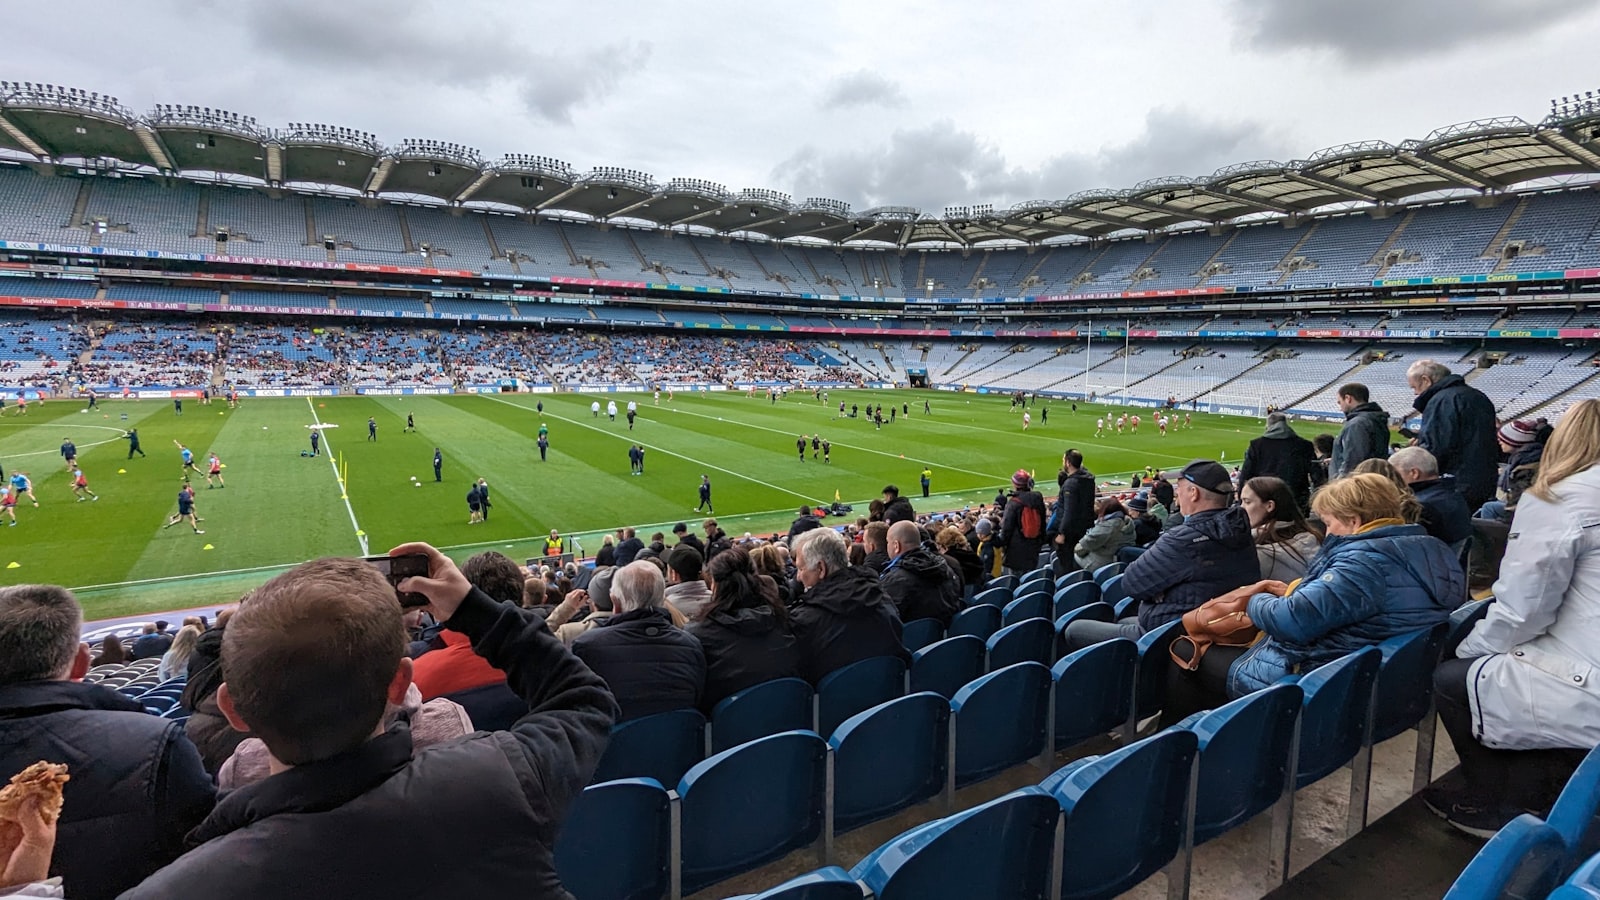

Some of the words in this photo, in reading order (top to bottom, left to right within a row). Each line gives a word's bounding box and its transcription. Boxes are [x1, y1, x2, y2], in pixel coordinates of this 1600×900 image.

[43, 243, 79, 253] Allianz
[102, 247, 135, 256] Allianz
[158, 250, 189, 260] Allianz
[1486, 273, 1517, 281] Centra
[21, 297, 58, 305] SuperValu
[401, 310, 424, 318] Allianz
[441, 312, 462, 320] Allianz
[478, 313, 499, 321] Allianz
[1499, 329, 1531, 337] Centra
[291, 388, 320, 396] Allianz
[365, 387, 391, 395] Allianz
[413, 387, 439, 395] Allianz
